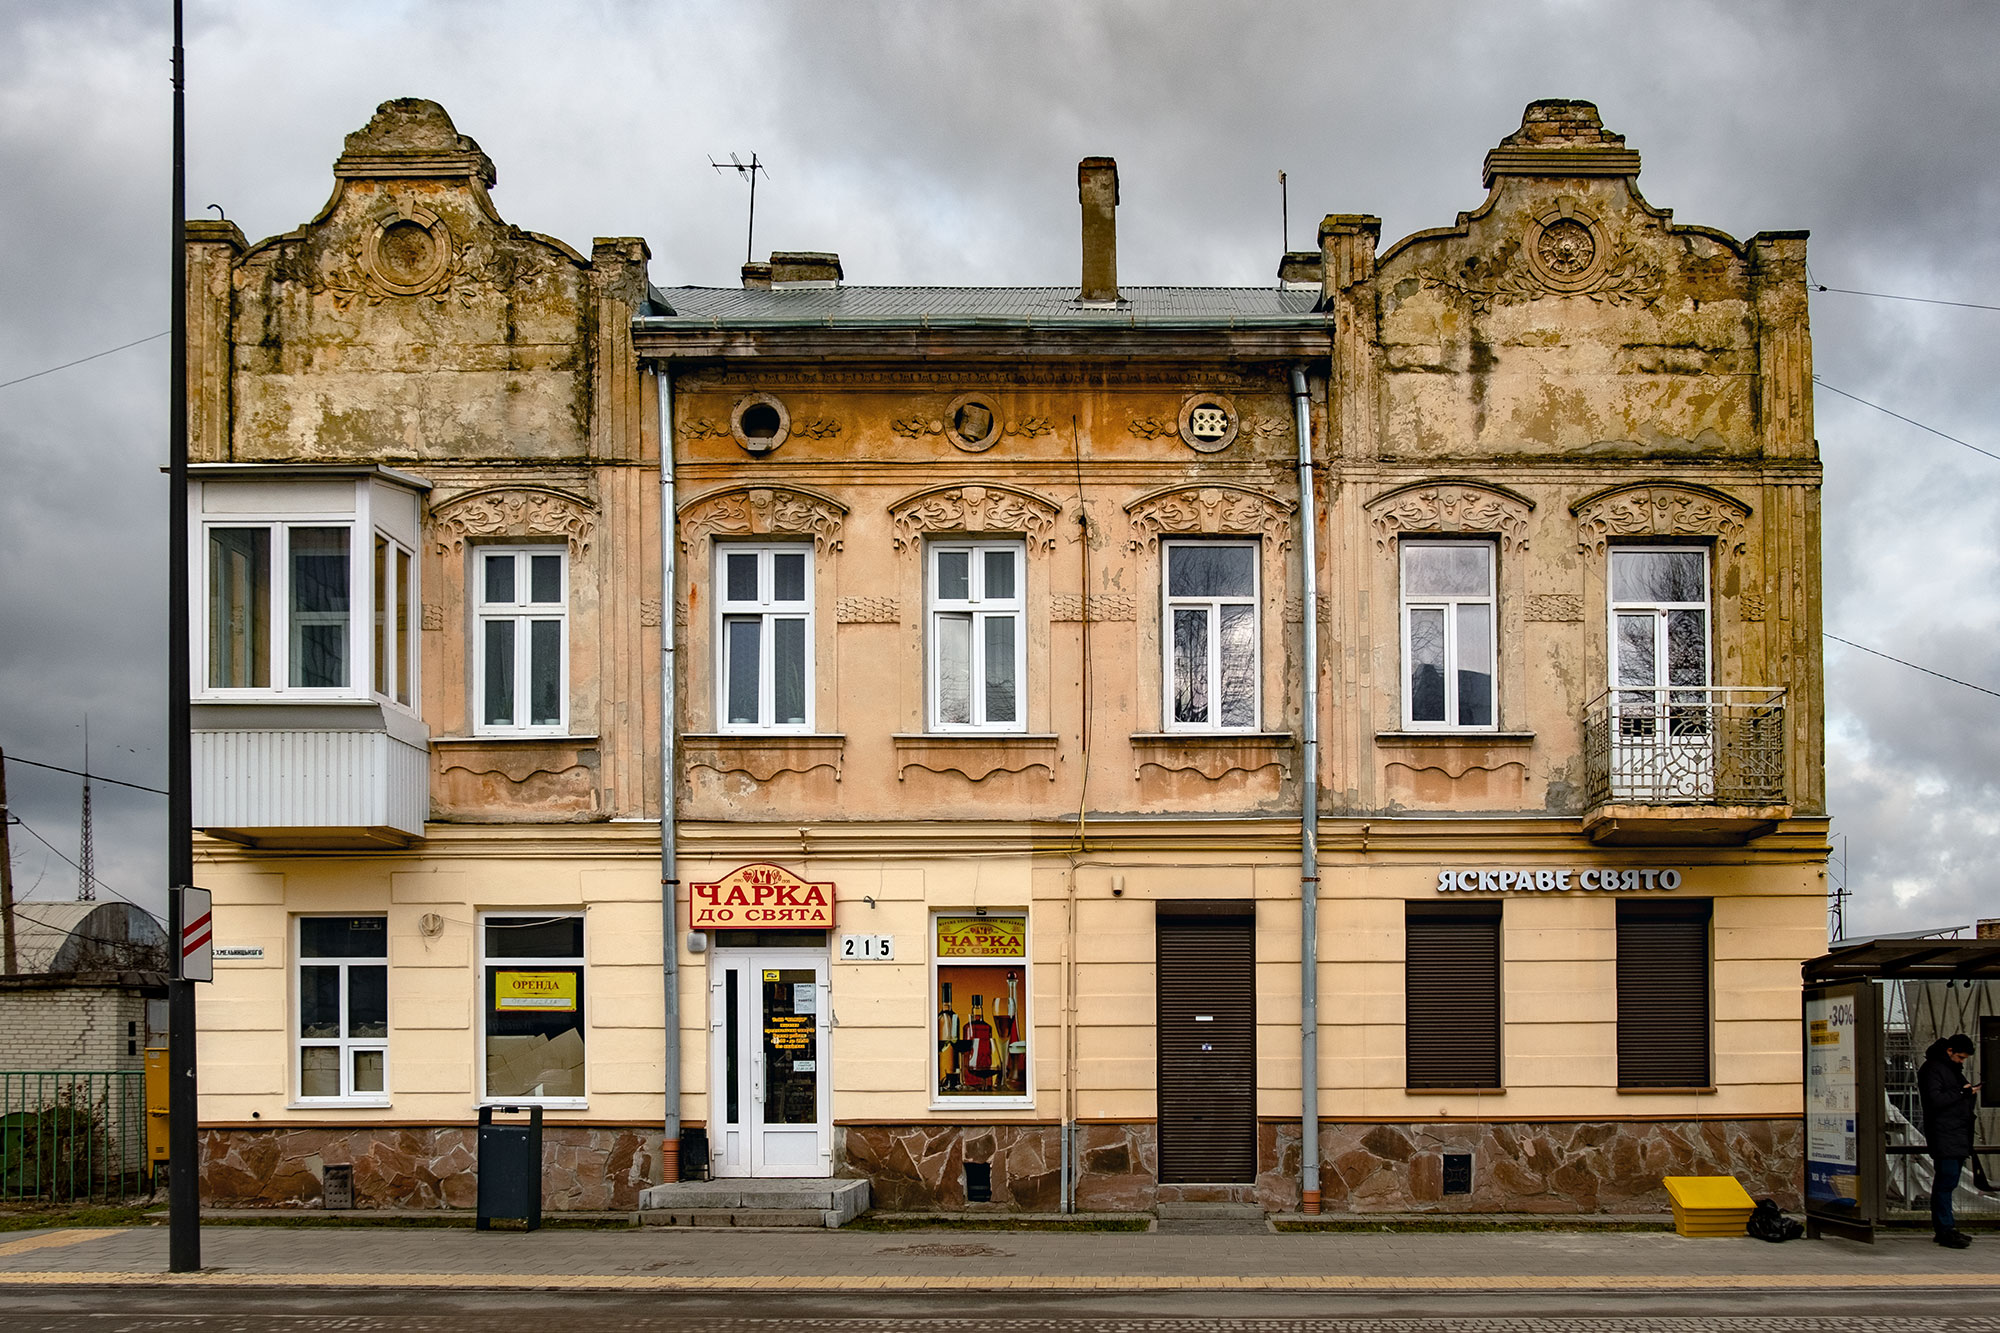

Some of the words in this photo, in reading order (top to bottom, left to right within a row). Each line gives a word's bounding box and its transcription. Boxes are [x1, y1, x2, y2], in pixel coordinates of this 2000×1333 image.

[1437, 869, 1573, 892] ЯСКРАВЕ
[1579, 869, 1682, 891] СВЯТО
[694, 885, 828, 906] ЧАРКА
[697, 909, 734, 923] ДО
[745, 909, 826, 921] СВЯТА
[941, 935, 1022, 947] ЧАРКА
[945, 947, 967, 955] ДО
[512, 980, 560, 991] ОРЕНДА
[1829, 1004, 1854, 1027] -30%
